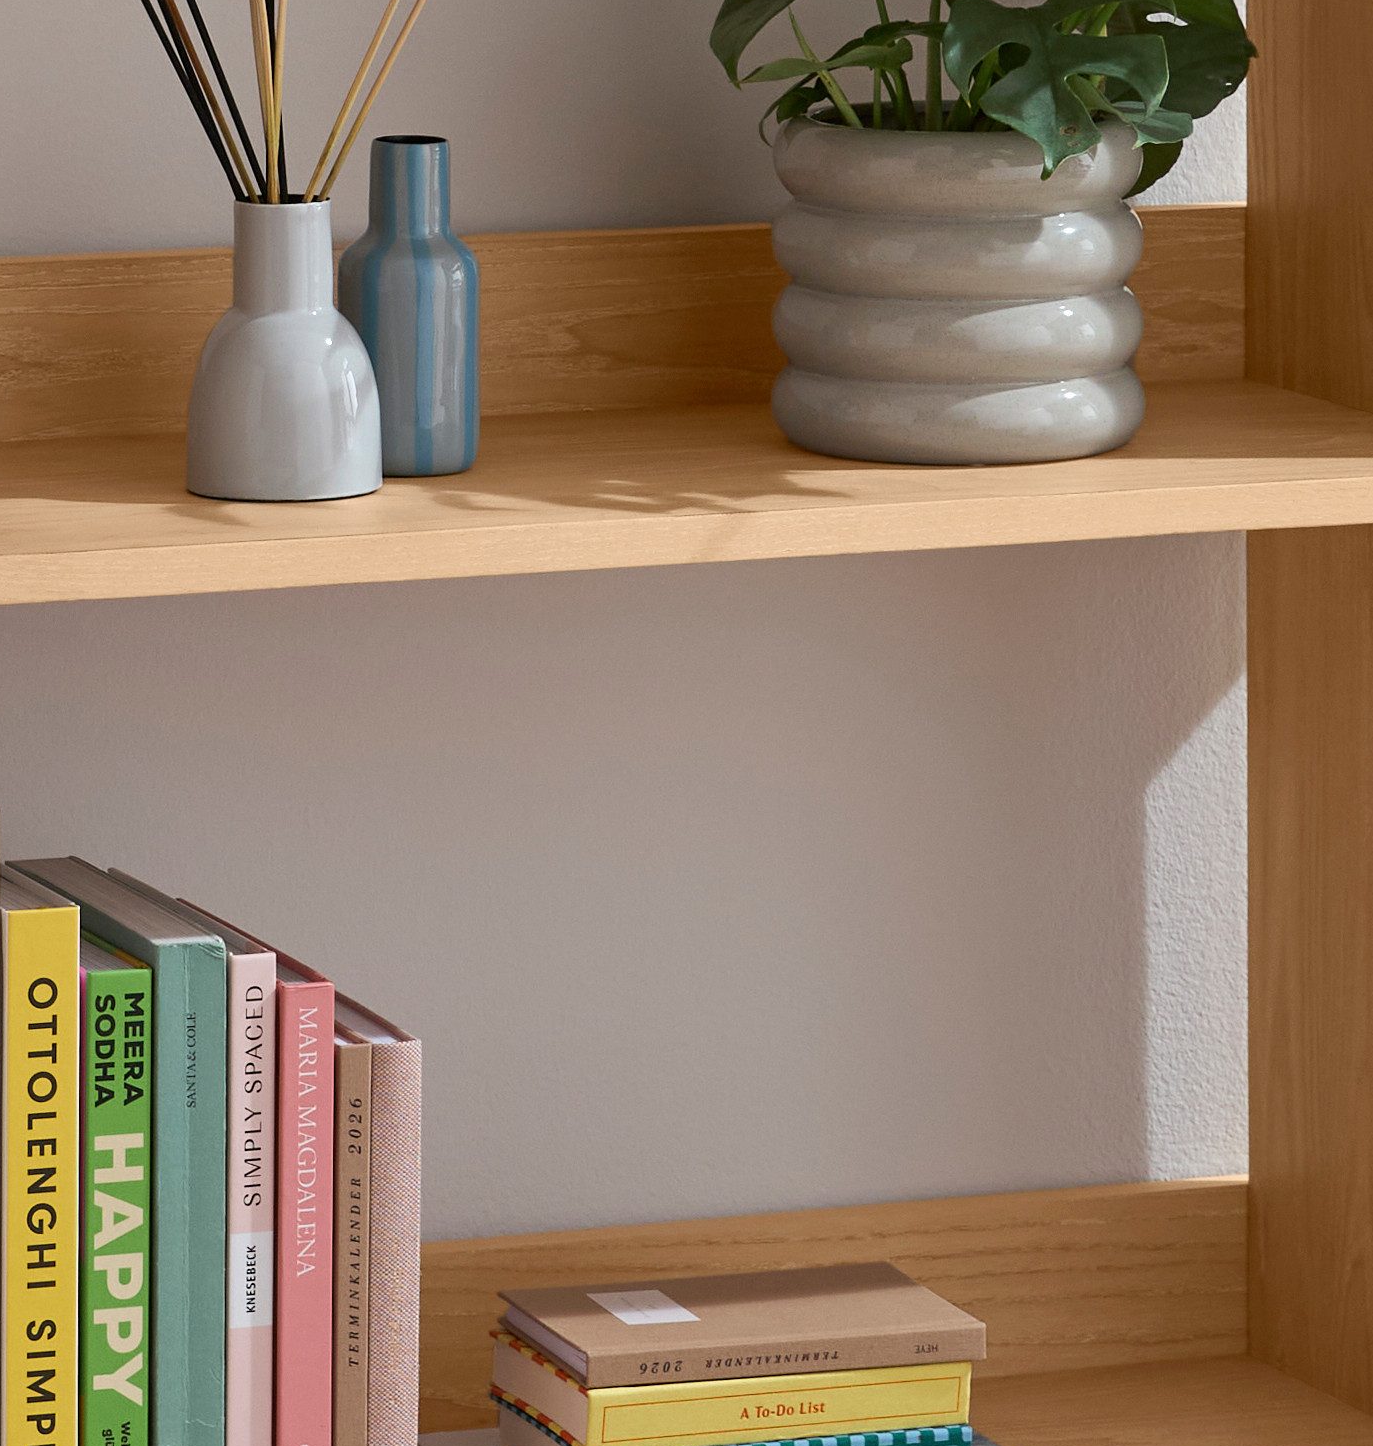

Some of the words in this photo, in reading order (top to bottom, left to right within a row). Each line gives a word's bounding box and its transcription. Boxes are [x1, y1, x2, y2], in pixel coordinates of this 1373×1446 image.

[95, 994, 116, 1108] SODHA
[123, 992, 145, 1106] MEERA
[186, 1012, 196, 1048] COLE
[188, 1052, 196, 1064] &
[244, 985, 264, 1094] SPACED
[297, 1006, 318, 1098] MARIA
[186, 1065, 196, 1107] SANTA
[347, 1097, 363, 1155] 2026
[26, 977, 58, 1290] OTTOLENGHI
[243, 1106, 262, 1206] SIMPLY
[296, 1105, 317, 1278] MAGDALENA
[93, 1132, 145, 1407] HAPPY
[245, 1245, 257, 1313] KNESEBECK
[348, 1177, 362, 1368] TERMINKALENDER
[639, 1360, 683, 1375] 2026
[705, 1351, 840, 1369] TERMINKALENDER
[914, 1344, 939, 1354] HEYE
[740, 1407, 749, 1419] A
[755, 1404, 794, 1418] To-Do
[799, 1402, 826, 1415] List
